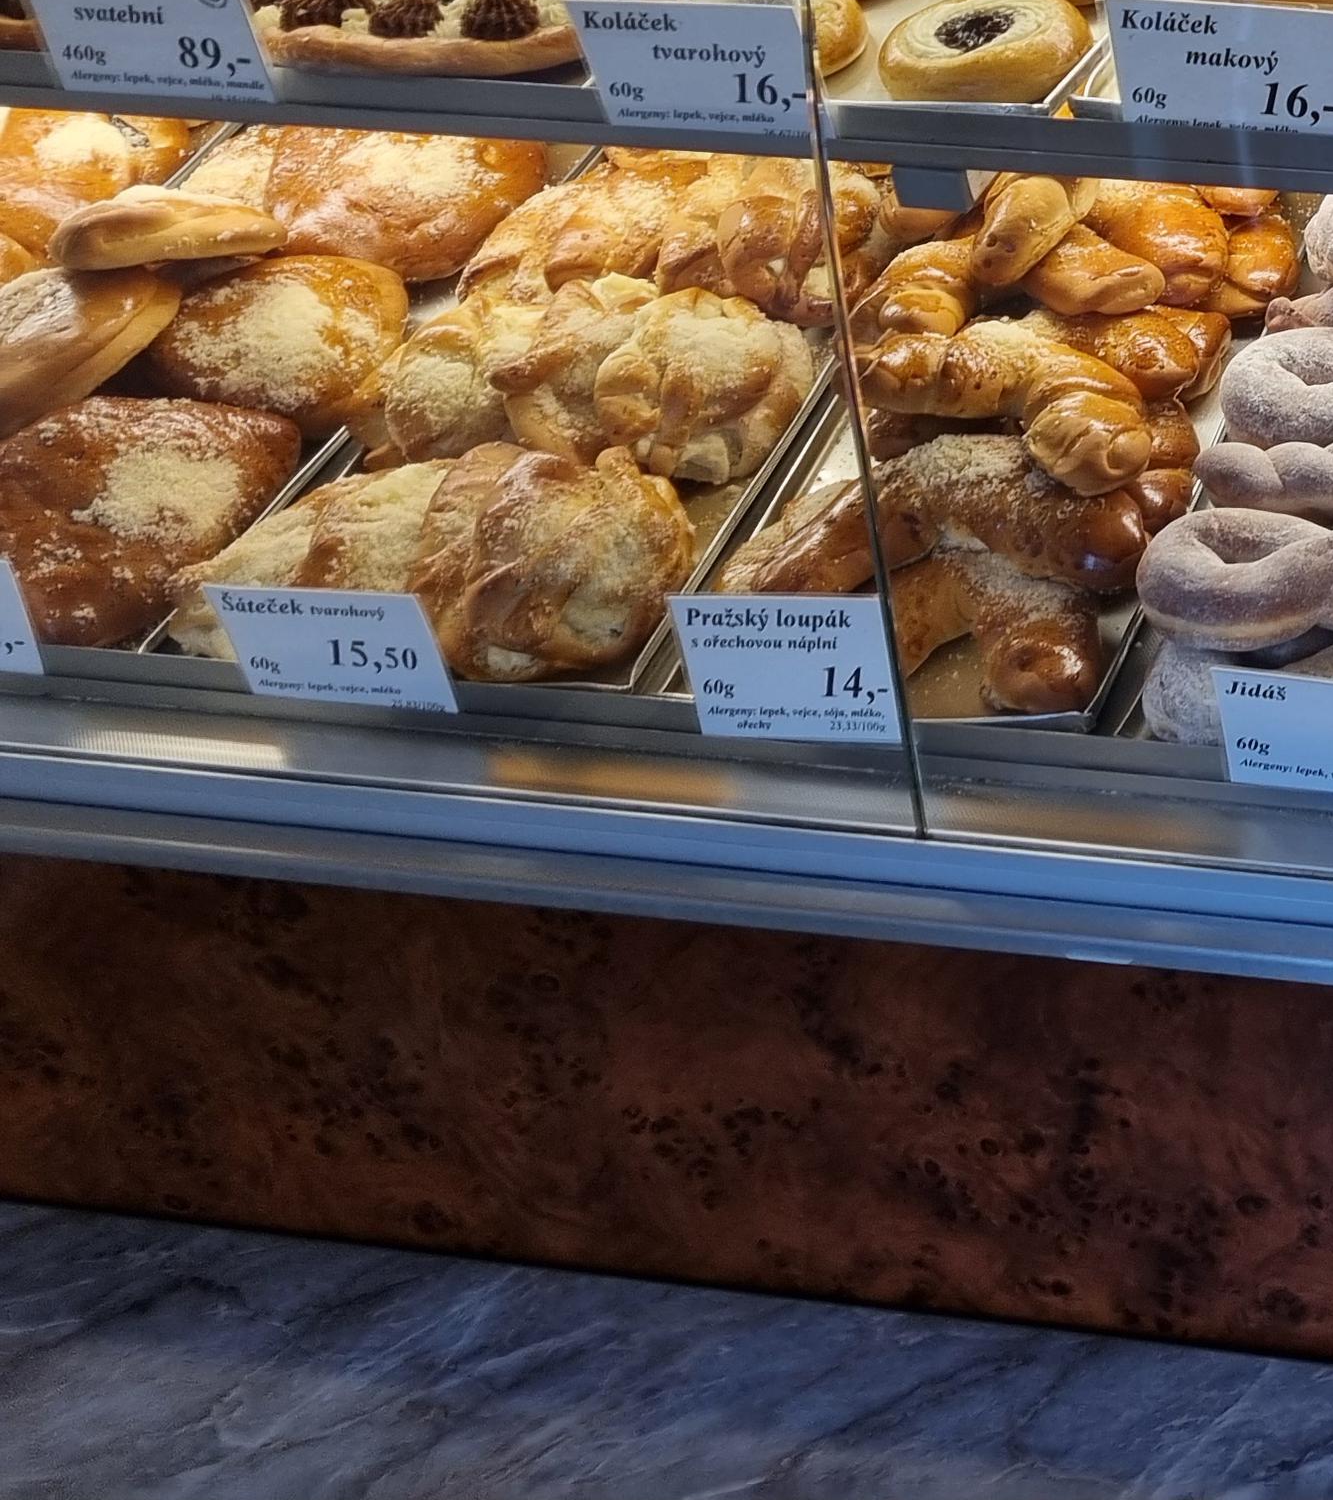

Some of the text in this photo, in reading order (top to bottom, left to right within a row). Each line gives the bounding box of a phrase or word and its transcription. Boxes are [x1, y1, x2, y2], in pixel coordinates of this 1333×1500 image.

[74, 4, 164, 25] svatební
[582, 10, 677, 32] Koláček
[1121, 9, 1218, 35] Koláček
[62, 36, 251, 77] 460g 89,-
[653, 44, 766, 68] tvarohový
[1186, 48, 1278, 75] makový
[609, 73, 807, 112] 60g 16,-
[1132, 86, 1167, 109] 60g
[222, 591, 385, 621] Šáteček tvarohový
[686, 608, 851, 632] Pražský loupák
[691, 636, 838, 652] s ořechovou náplní
[250, 639, 418, 675] 60g 15,50
[703, 665, 888, 704] 60g 14,-
[1225, 681, 1287, 701] Jidáš
[1236, 736, 1270, 756] 60g
